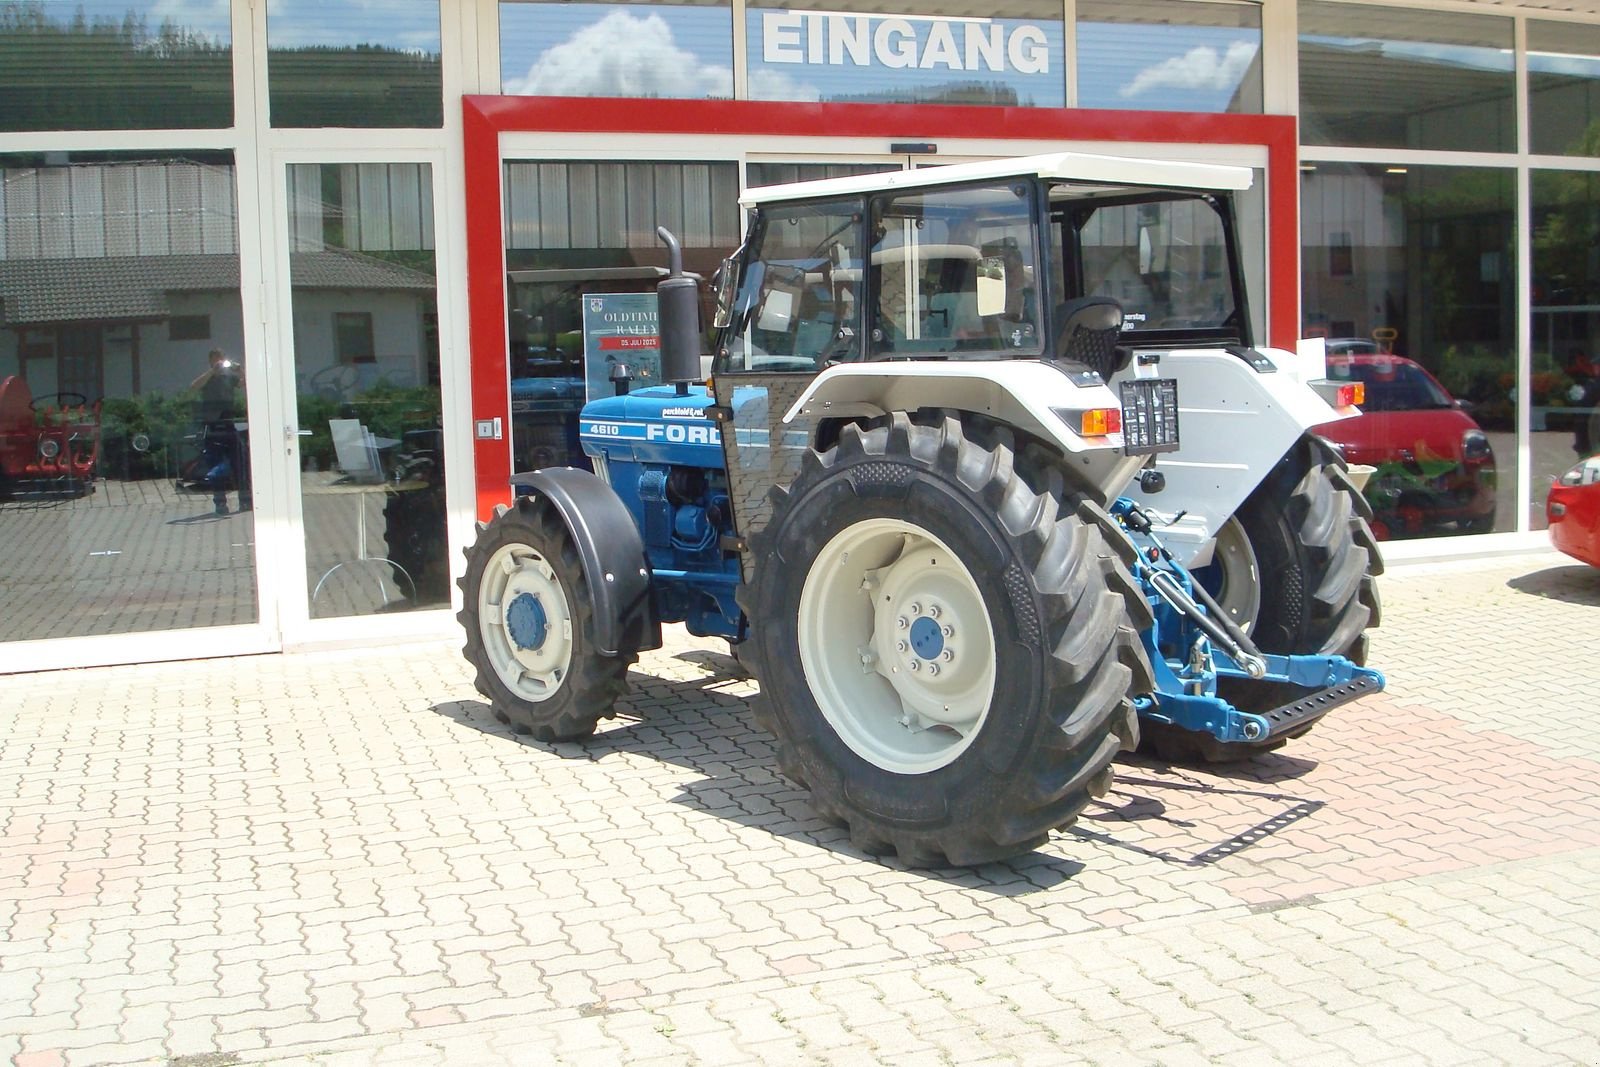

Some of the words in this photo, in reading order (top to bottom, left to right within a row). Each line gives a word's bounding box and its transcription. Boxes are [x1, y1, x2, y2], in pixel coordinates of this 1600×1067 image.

[763, 12, 1049, 74] EINGANG
[604, 312, 658, 321] OLDTIM
[590, 424, 619, 436] 4610
